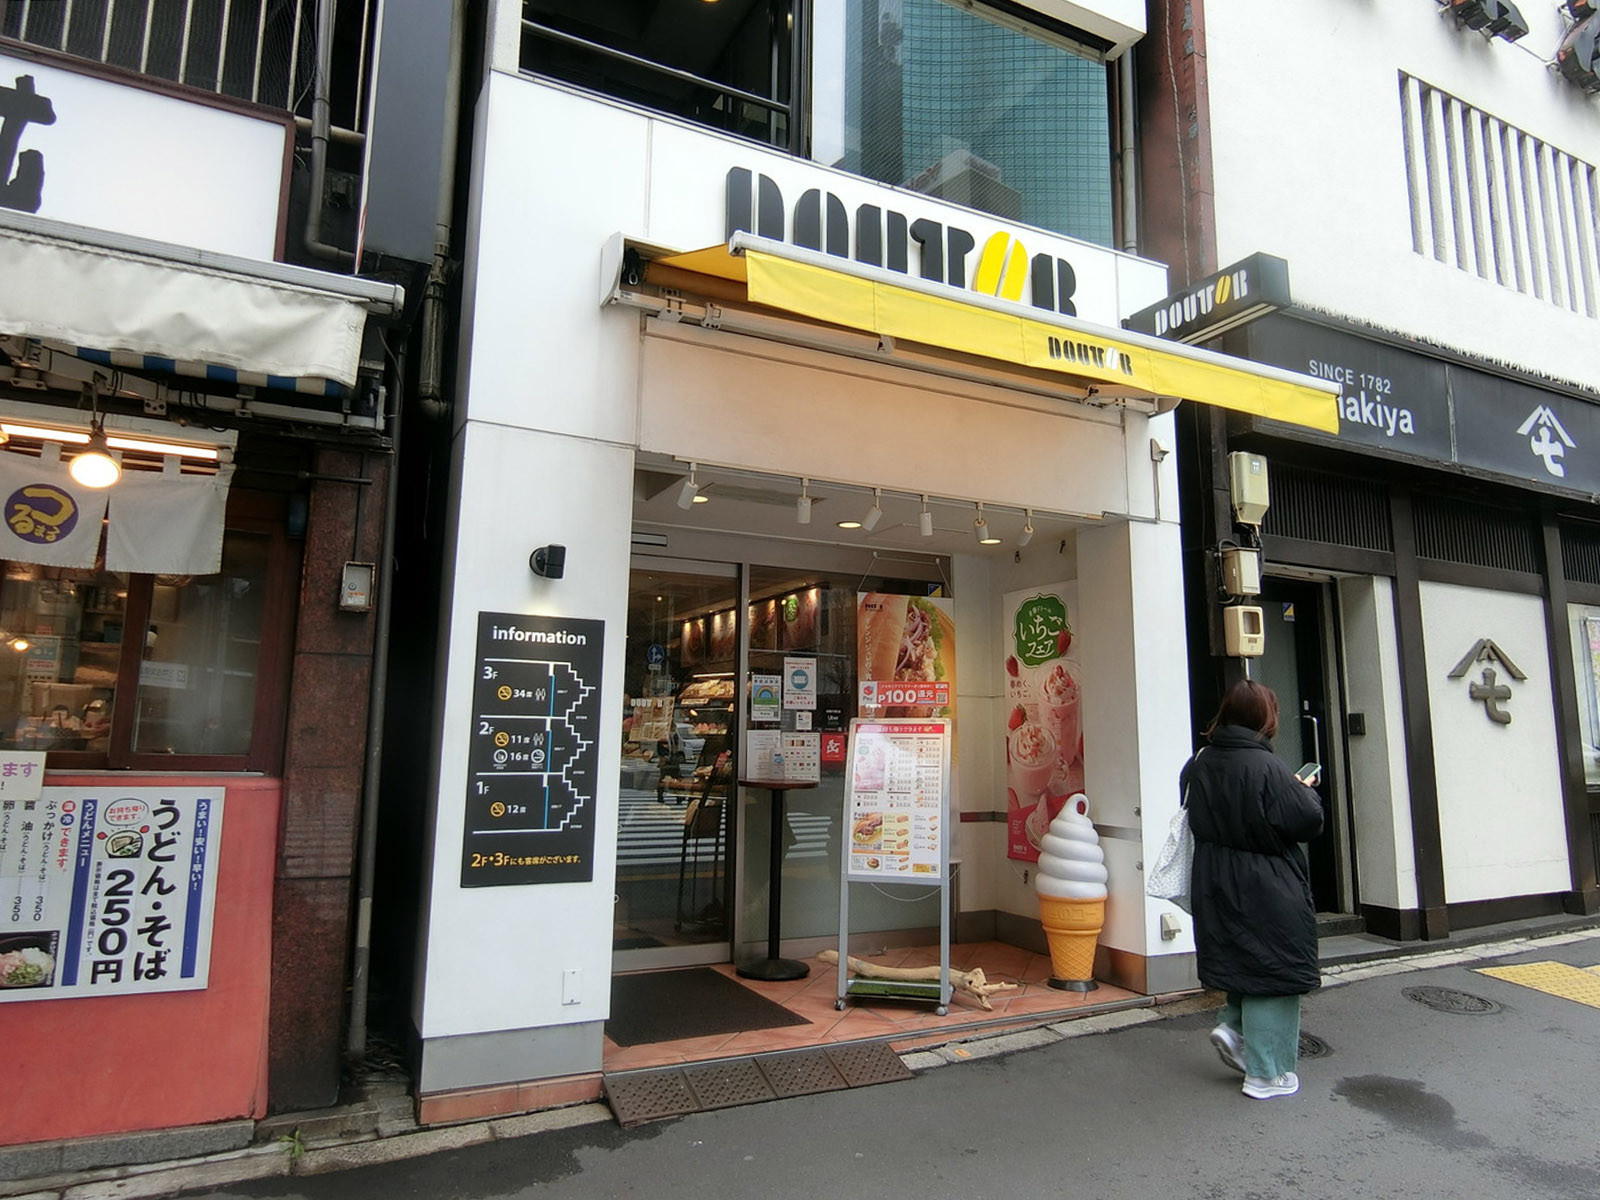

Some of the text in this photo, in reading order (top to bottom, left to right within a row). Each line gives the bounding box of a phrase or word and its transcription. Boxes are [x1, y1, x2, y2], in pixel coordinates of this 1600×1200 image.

[725, 165, 1078, 318] DOUTOR
[1153, 268, 1248, 339] DOUTOR
[1048, 335, 1133, 376] DOUTOR
[1308, 359, 1392, 395] SINCE 1782
[492, 625, 587, 646] information
[1020, 615, 1063, 641] いちご
[482, 666, 499, 680] 3F
[478, 721, 494, 735] 2F
[476, 781, 490, 795] 1F
[80, 802, 95, 867] うどんメニュー
[134, 799, 181, 981] うどん・そば
[90, 868, 136, 985] 250円
